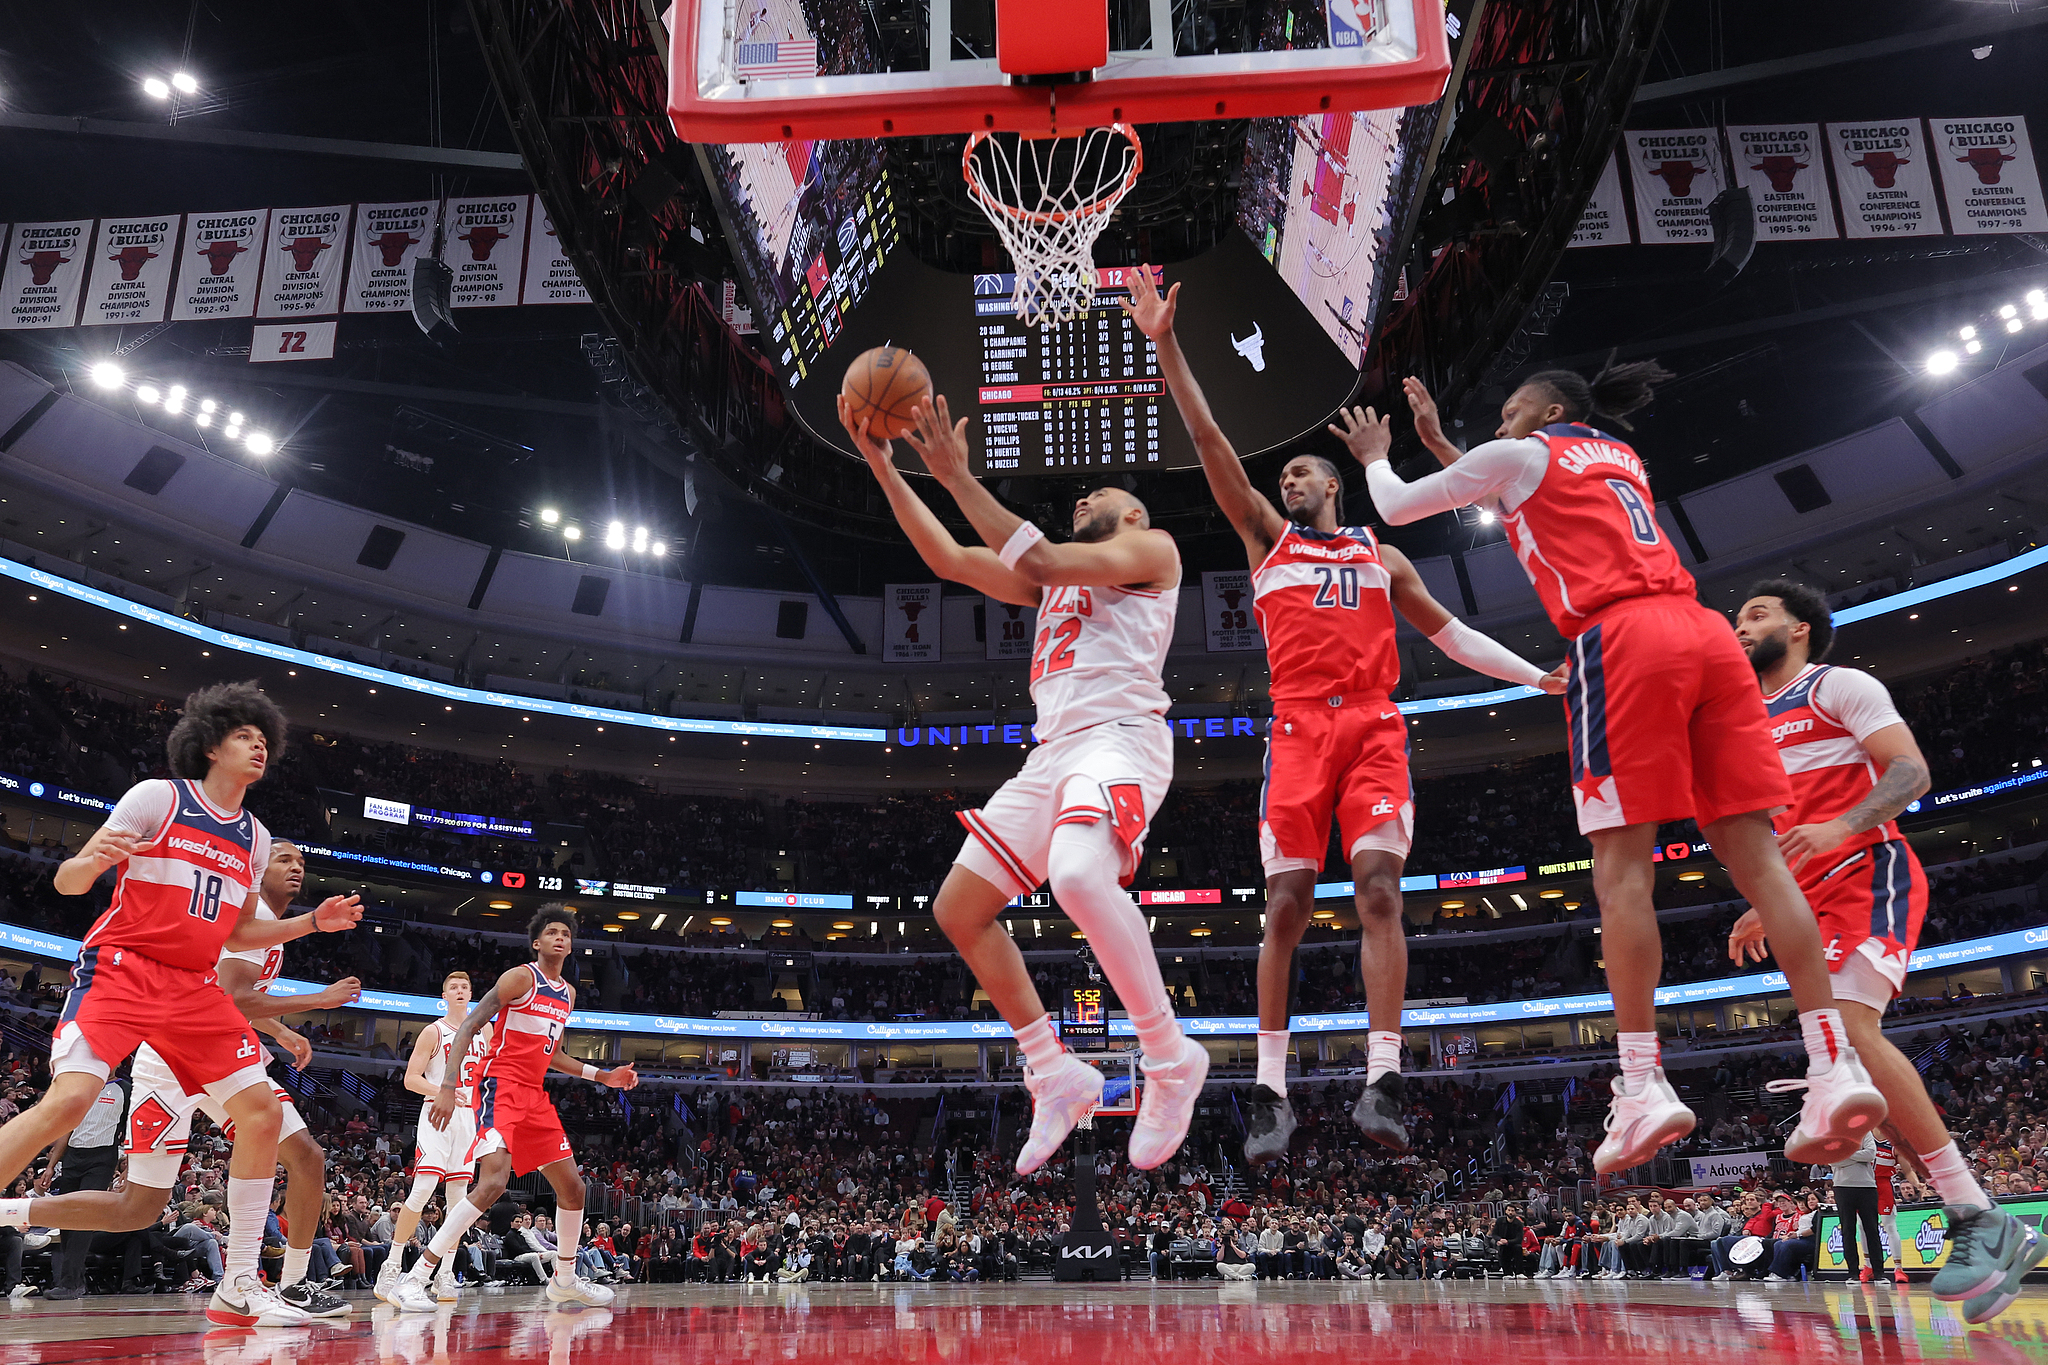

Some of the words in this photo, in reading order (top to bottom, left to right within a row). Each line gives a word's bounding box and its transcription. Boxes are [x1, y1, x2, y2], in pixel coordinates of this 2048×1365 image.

[1335, 31, 1358, 46] NBA
[1840, 126, 1910, 139] CHICAGO
[1944, 122, 2014, 135] CHICAGO
[1853, 138, 1902, 151] BULLS
[1956, 135, 2007, 147] BULLS
[1866, 190, 1908, 200] EASTERN
[1972, 187, 2013, 196] EASTERN
[456, 202, 517, 214] CHICAGO
[1859, 201, 1921, 211] CONFERENCE
[1964, 197, 2026, 207] CONFERENCE
[280, 212, 341, 225] CHICAGO
[1862, 211, 1922, 222] CHAMPIONS
[1967, 208, 2027, 218] CHAMPIONS
[197, 216, 257, 229] CHICAGO
[464, 214, 508, 225] BULLS
[1977, 219, 2022, 229] 1997-98
[21, 227, 81, 239] CHICAGO
[109, 222, 168, 235] CHICAGO
[288, 224, 331, 236] BULLS
[1870, 223, 1917, 232] 1996-97
[116, 234, 159, 245] BULLS
[204, 228, 247, 240] BULLS
[28, 239, 71, 250] BULLS
[461, 263, 498, 272] CENTRAL
[199, 276, 235, 285] CENTRAL
[285, 272, 320, 281] CENTRAL
[459, 273, 498, 282] DIVISION
[1107, 270, 1122, 286] 12
[22, 286, 57, 295] CENTRAL
[110, 282, 145, 290] CENTRAL
[196, 286, 235, 294] DIVISION
[282, 281, 320, 291] DIVISION
[451, 283, 503, 293] CHAMPIONS
[108, 291, 146, 300] DIVISION
[188, 294, 239, 304] CHAMPIONS
[273, 291, 324, 302] CHAMPIONS
[457, 293, 496, 303] 1997-98
[549, 289, 586, 298] 2010-11
[19, 296, 57, 304] DIVISION
[99, 300, 150, 310] CHAMPIONS
[364, 299, 404, 309] 1996-97
[11, 305, 61, 314] CHAMPIONS
[194, 305, 230, 314] 1992-93
[280, 302, 316, 312] 1995-96
[16, 315, 51, 324] 1990-91
[105, 310, 141, 319] 1991-92
[979, 326, 988, 336] 20
[988, 325, 1005, 335] SARR
[279, 331, 307, 354] 72
[989, 336, 1027, 347] CHAMPAGNIE
[1098, 331, 1109, 342] 3/3
[990, 348, 1027, 359] CARRINGTON
[982, 362, 990, 371] 18
[990, 360, 1014, 371] GEORGE
[1099, 355, 1109, 365] 2/4
[1124, 354, 1133, 364] 1/3
[985, 374, 990, 383] 5
[991, 372, 1019, 383] JOHNSON
[981, 389, 1012, 400] CHICAGO
[983, 413, 992, 423] 22
[992, 410, 1039, 423] HORTON-TUCKER
[993, 423, 1018, 434] VUCEVIC
[1101, 419, 1111, 429] 3/4
[985, 436, 993, 446] 15
[993, 435, 1020, 446] PHILLIPS
[985, 448, 993, 458] 13
[994, 447, 1020, 457] HUERTER
[1102, 442, 1112, 452] 1/3
[986, 460, 994, 469] 14
[994, 458, 1019, 469] BUZELIS
[1557, 442, 1648, 486] CARRINGTON
[1605, 479, 1660, 545] 8
[30, 571, 65, 590] Culligan
[67, 585, 85, 596] Water
[85, 591, 97, 600] you
[1313, 567, 1360, 610] 20
[129, 604, 161, 622] Culligan
[1220, 610, 1247, 630] 33
[905, 623, 919, 643] 4
[1002, 620, 1025, 641] 10
[220, 634, 252, 650] Culligan
[1030, 617, 1082, 686] 22
[1934, 794, 1959, 805] Let's
[1958, 788, 1983, 799] unite
[1983, 778, 2017, 794] against
[58, 790, 80, 803] Let's
[80, 797, 104, 809] unite
[369, 802, 383, 810] FAN
[384, 805, 406, 814] ASSIST
[368, 809, 405, 820] PROGRAM
[415, 813, 433, 822] TEXT
[433, 816, 444, 824] 773
[444, 818, 456, 826] 900
[456, 820, 472, 828] 6176
[472, 822, 487, 830] FOR
[488, 823, 533, 834] ASSISTANCE
[310, 846, 332, 856] unite
[332, 850, 361, 862] against
[362, 854, 389, 865] plastic
[389, 859, 411, 868] water
[440, 867, 472, 880] Chicago.
[1538, 863, 1567, 876] POINTS
[1566, 862, 1576, 872] IN
[1576, 860, 1591, 870] THE
[1478, 868, 1505, 878] WIZARDS
[538, 876, 562, 891] 7:23
[1479, 876, 1498, 885] BULLS
[613, 882, 642, 893] CHARLOTTE
[642, 885, 667, 894] HORNETS
[188, 869, 223, 922] 18
[612, 889, 634, 899] BOSTON
[634, 891, 654, 900] CELTICS
[866, 895, 890, 903] TIMEOUTS
[1030, 894, 1041, 906] 14
[1151, 891, 1186, 903] CHICAGO
[803, 897, 825, 905] CLUB
[12, 933, 33, 945] Water
[33, 939, 47, 948] you
[1937, 950, 1960, 960] Water
[1960, 948, 1975, 957] you
[1073, 989, 1101, 1002] 5:52
[1077, 1002, 1099, 1023] 12
[1522, 1001, 1561, 1015] Culligan
[1408, 1010, 1446, 1024] Culligan
[654, 1018, 690, 1032] Culligan
[692, 1023, 709, 1031] Water
[761, 1023, 796, 1036] Culligan
[799, 1026, 818, 1034] Water
[867, 1024, 902, 1037] Culligan
[1190, 1019, 1225, 1033] Culligan
[543, 1022, 557, 1055] 5
